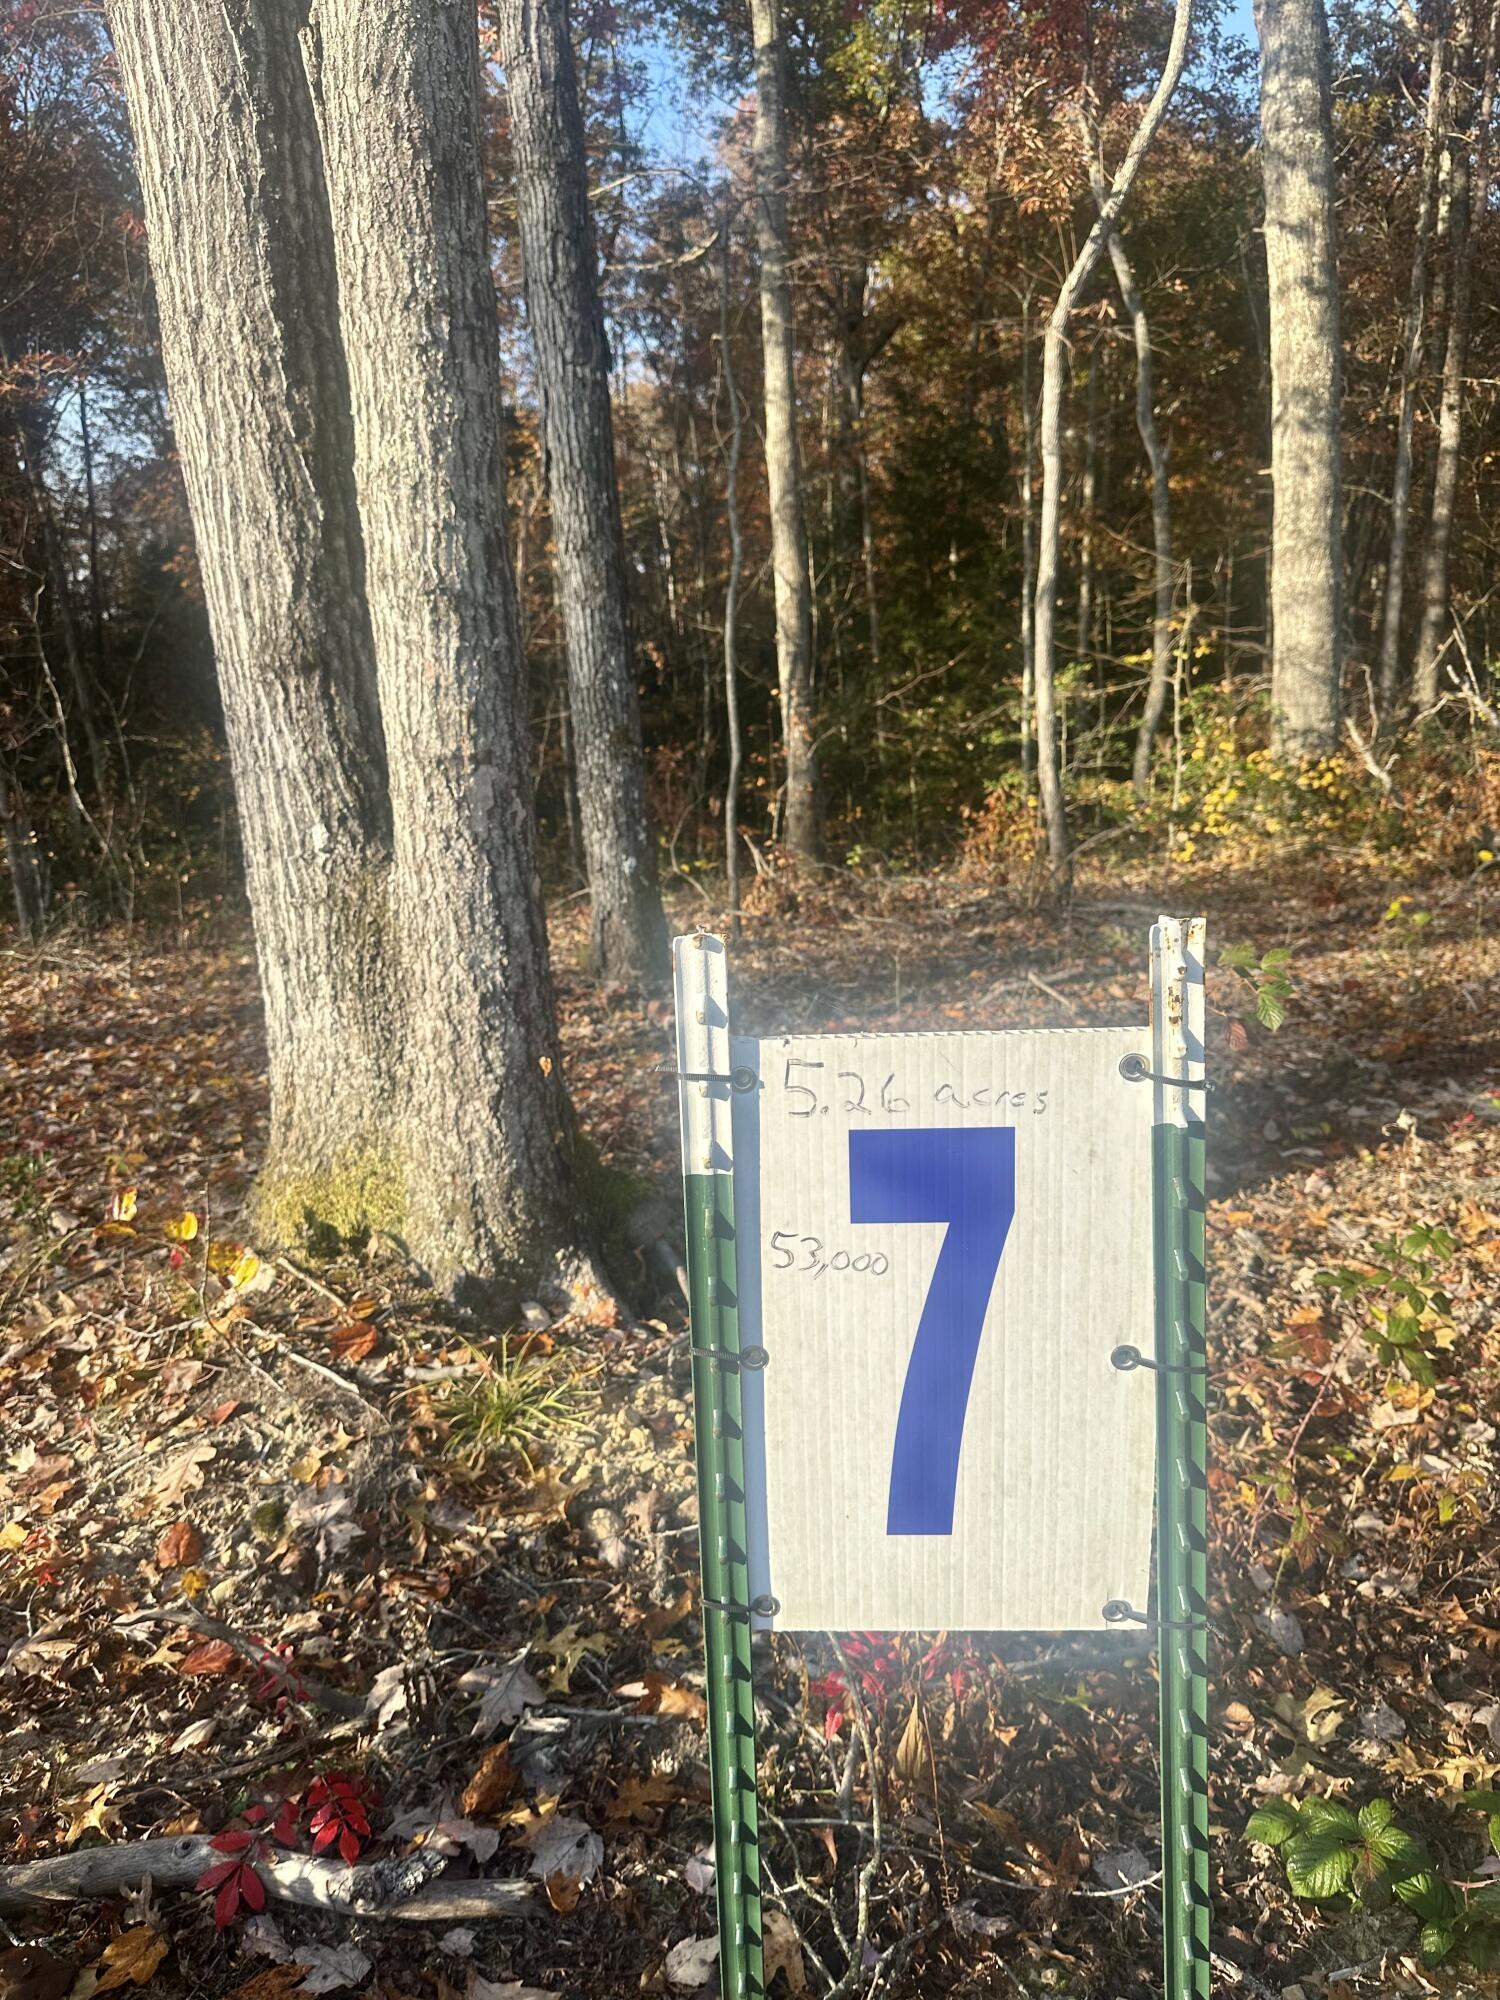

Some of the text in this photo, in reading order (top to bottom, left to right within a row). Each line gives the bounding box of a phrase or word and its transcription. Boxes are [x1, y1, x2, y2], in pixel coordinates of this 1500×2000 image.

[784, 1058, 1049, 1117] 5.26 acres
[770, 1230, 889, 1280] 53,000
[848, 1127, 1015, 1535] 7
